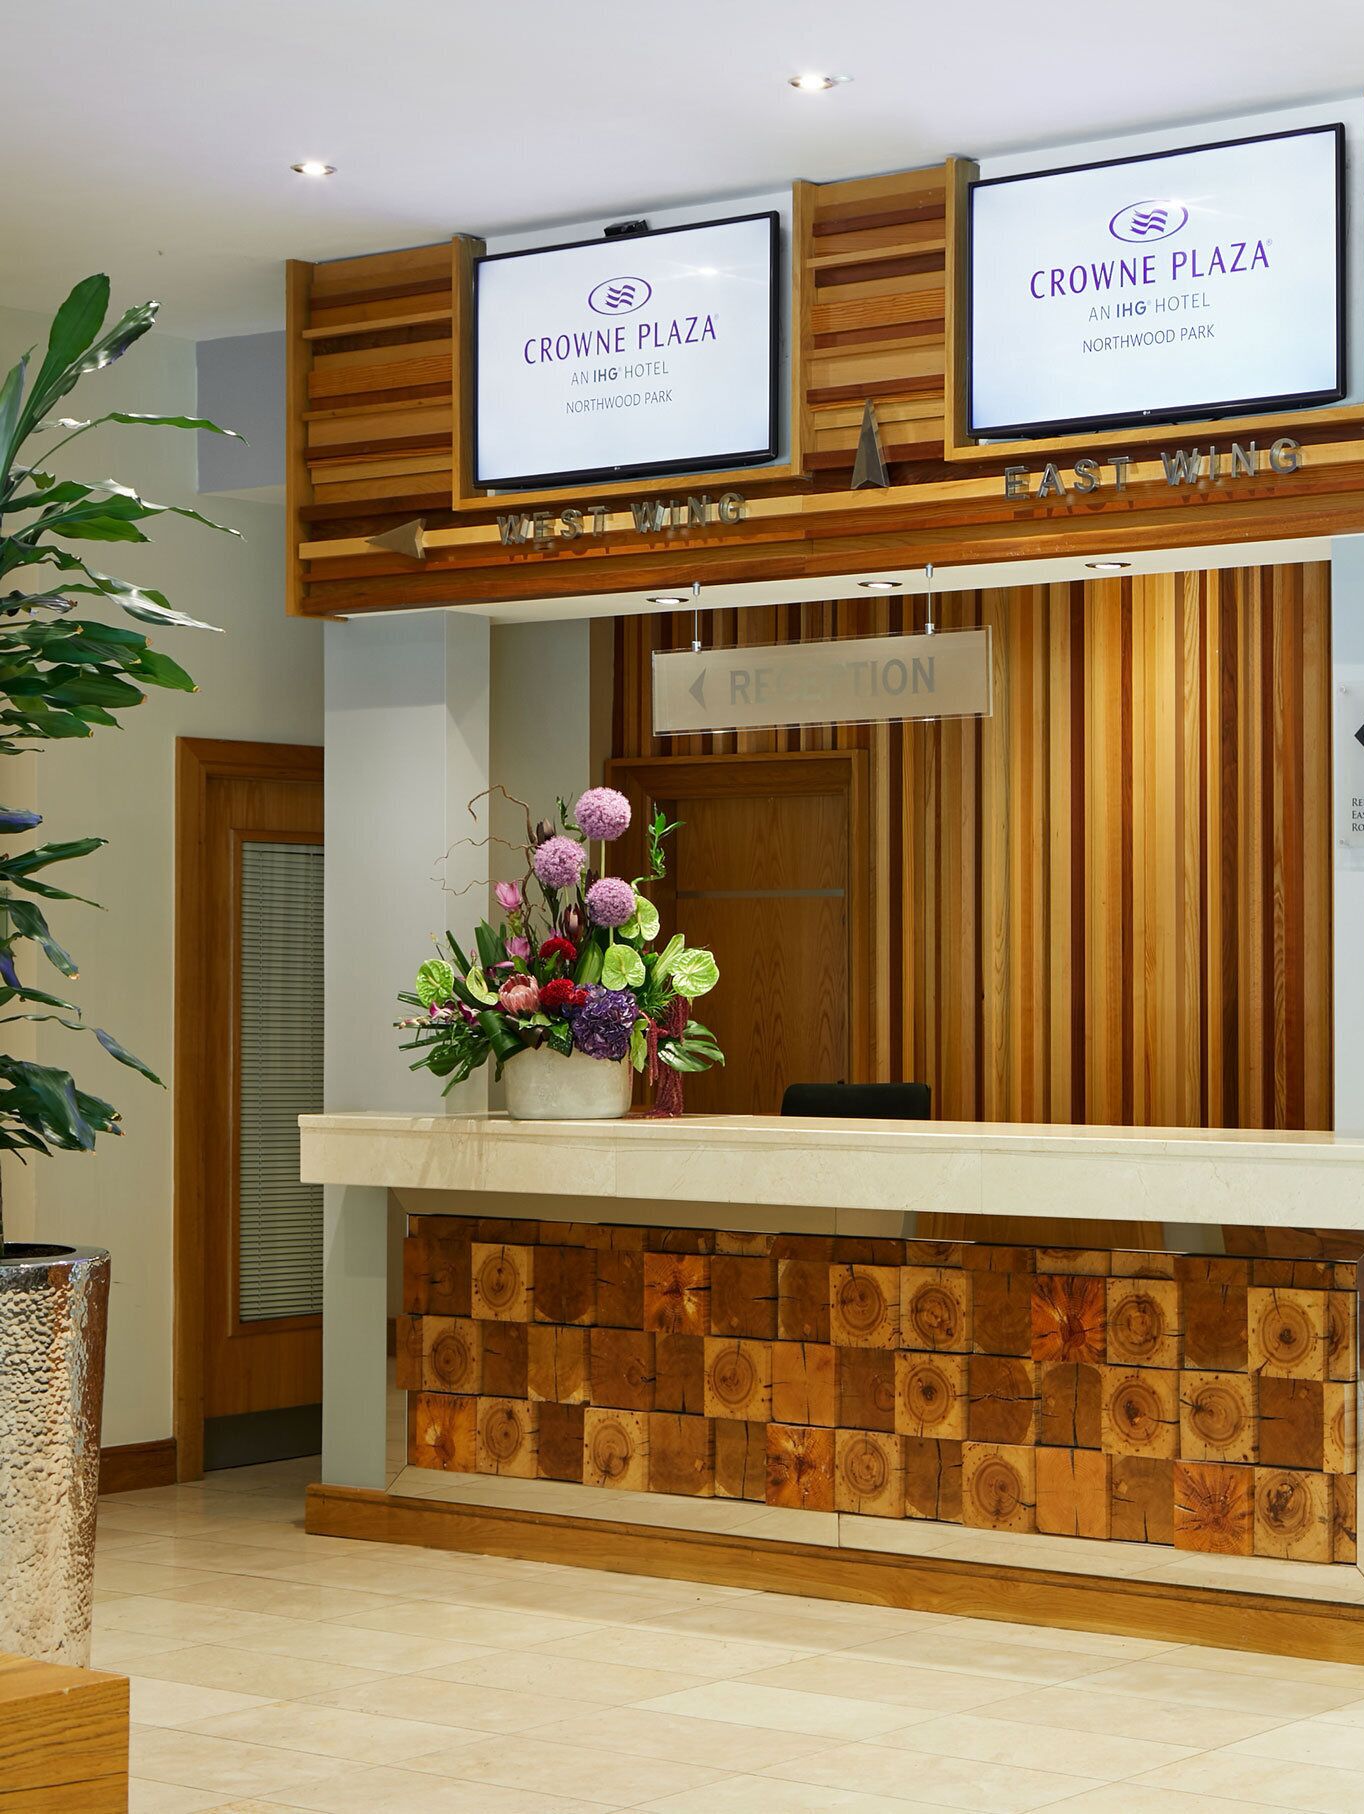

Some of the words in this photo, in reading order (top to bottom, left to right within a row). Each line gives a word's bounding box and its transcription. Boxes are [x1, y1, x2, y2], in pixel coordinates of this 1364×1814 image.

[1030, 255, 1156, 299] CROWNE
[1172, 240, 1269, 280] PLAZA
[1088, 305, 1110, 322] AN
[1116, 301, 1147, 317] IHG
[1155, 292, 1210, 313] HOTEL
[524, 326, 625, 364] CROWNE
[638, 315, 716, 349] PLAZA
[1083, 329, 1175, 353] NORTHWOOD
[1180, 324, 1215, 341] PARK
[571, 371, 589, 386] AN
[593, 367, 618, 382] IHG
[624, 361, 668, 379] HOTEL
[566, 393, 640, 413] NORTHWOOD
[645, 389, 672, 404] PARK
[1004, 456, 1131, 500] EAST
[1160, 437, 1301, 486] WING
[496, 505, 608, 545] WEST
[630, 492, 746, 533] WING
[730, 656, 935, 705] RETION
